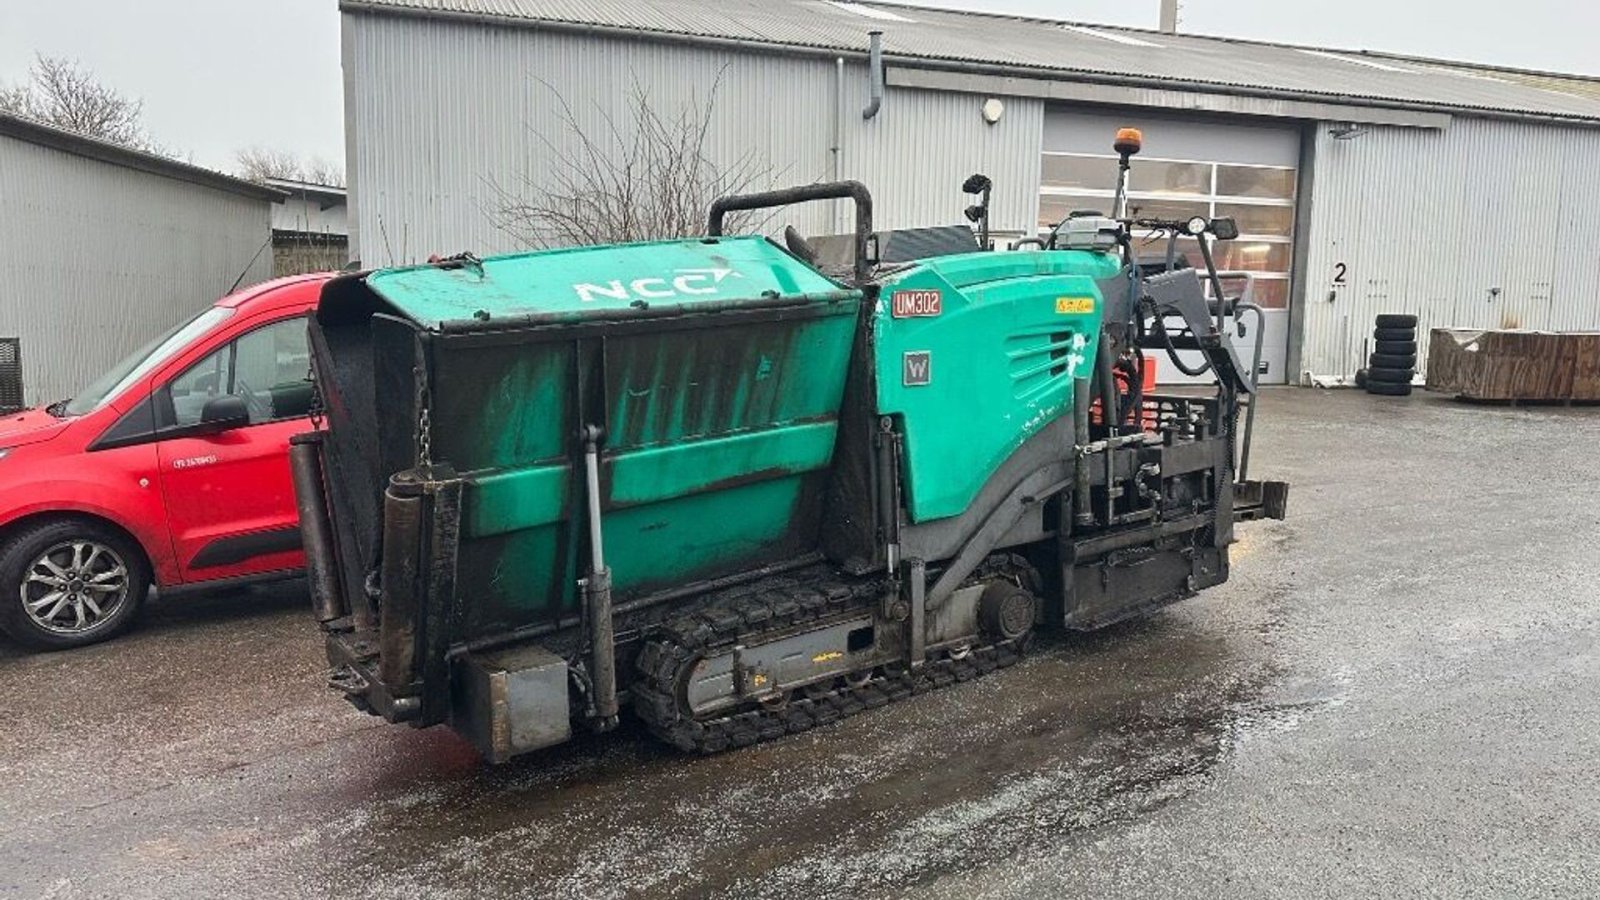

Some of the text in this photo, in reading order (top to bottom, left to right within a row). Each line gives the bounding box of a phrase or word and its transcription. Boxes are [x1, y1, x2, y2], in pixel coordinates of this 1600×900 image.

[1334, 262, 1346, 282] 2
[572, 269, 736, 302] NCC
[896, 292, 939, 314] UM302
[907, 359, 928, 378] W
